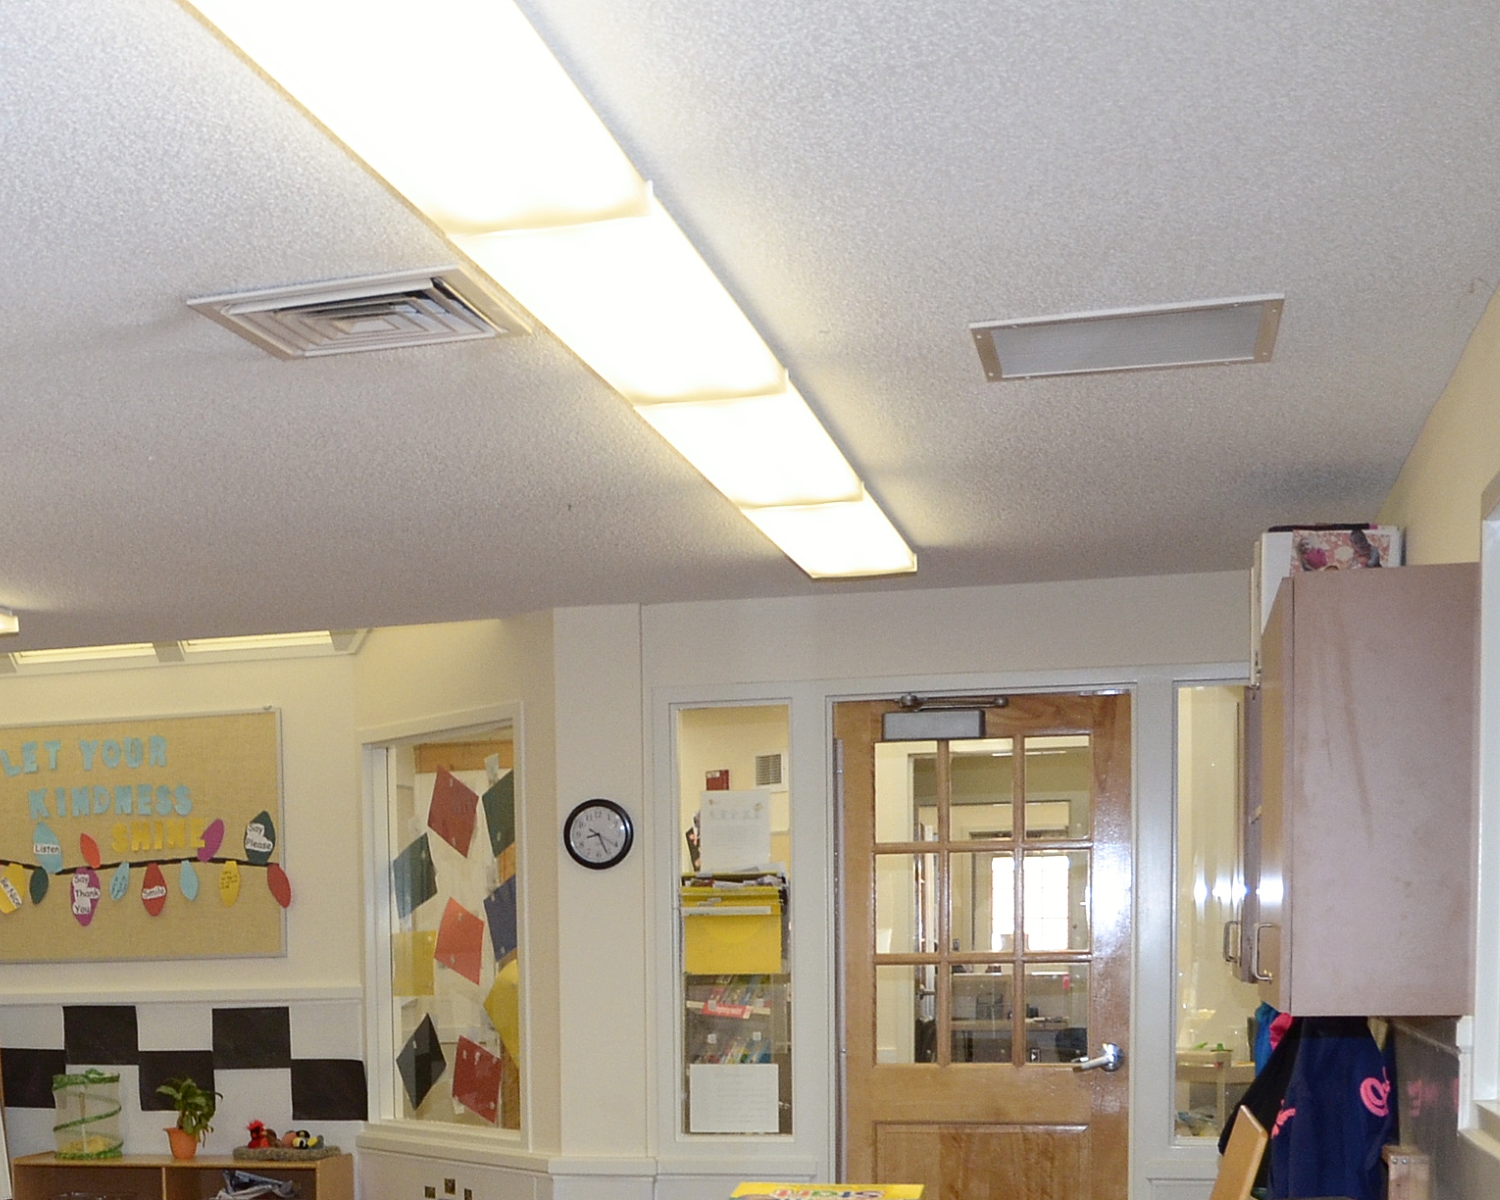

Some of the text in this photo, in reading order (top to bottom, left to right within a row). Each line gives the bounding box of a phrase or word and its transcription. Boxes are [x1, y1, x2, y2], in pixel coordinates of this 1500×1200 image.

[79, 735, 167, 771] YOUR
[28, 784, 193, 820] KINDNESS
[111, 818, 206, 853] SHINE
[245, 838, 271, 849] Please
[35, 844, 59, 853] Listen
[74, 875, 89, 884] Say
[75, 889, 99, 898] Thank
[143, 887, 165, 896] Smile
[75, 905, 90, 913] You
